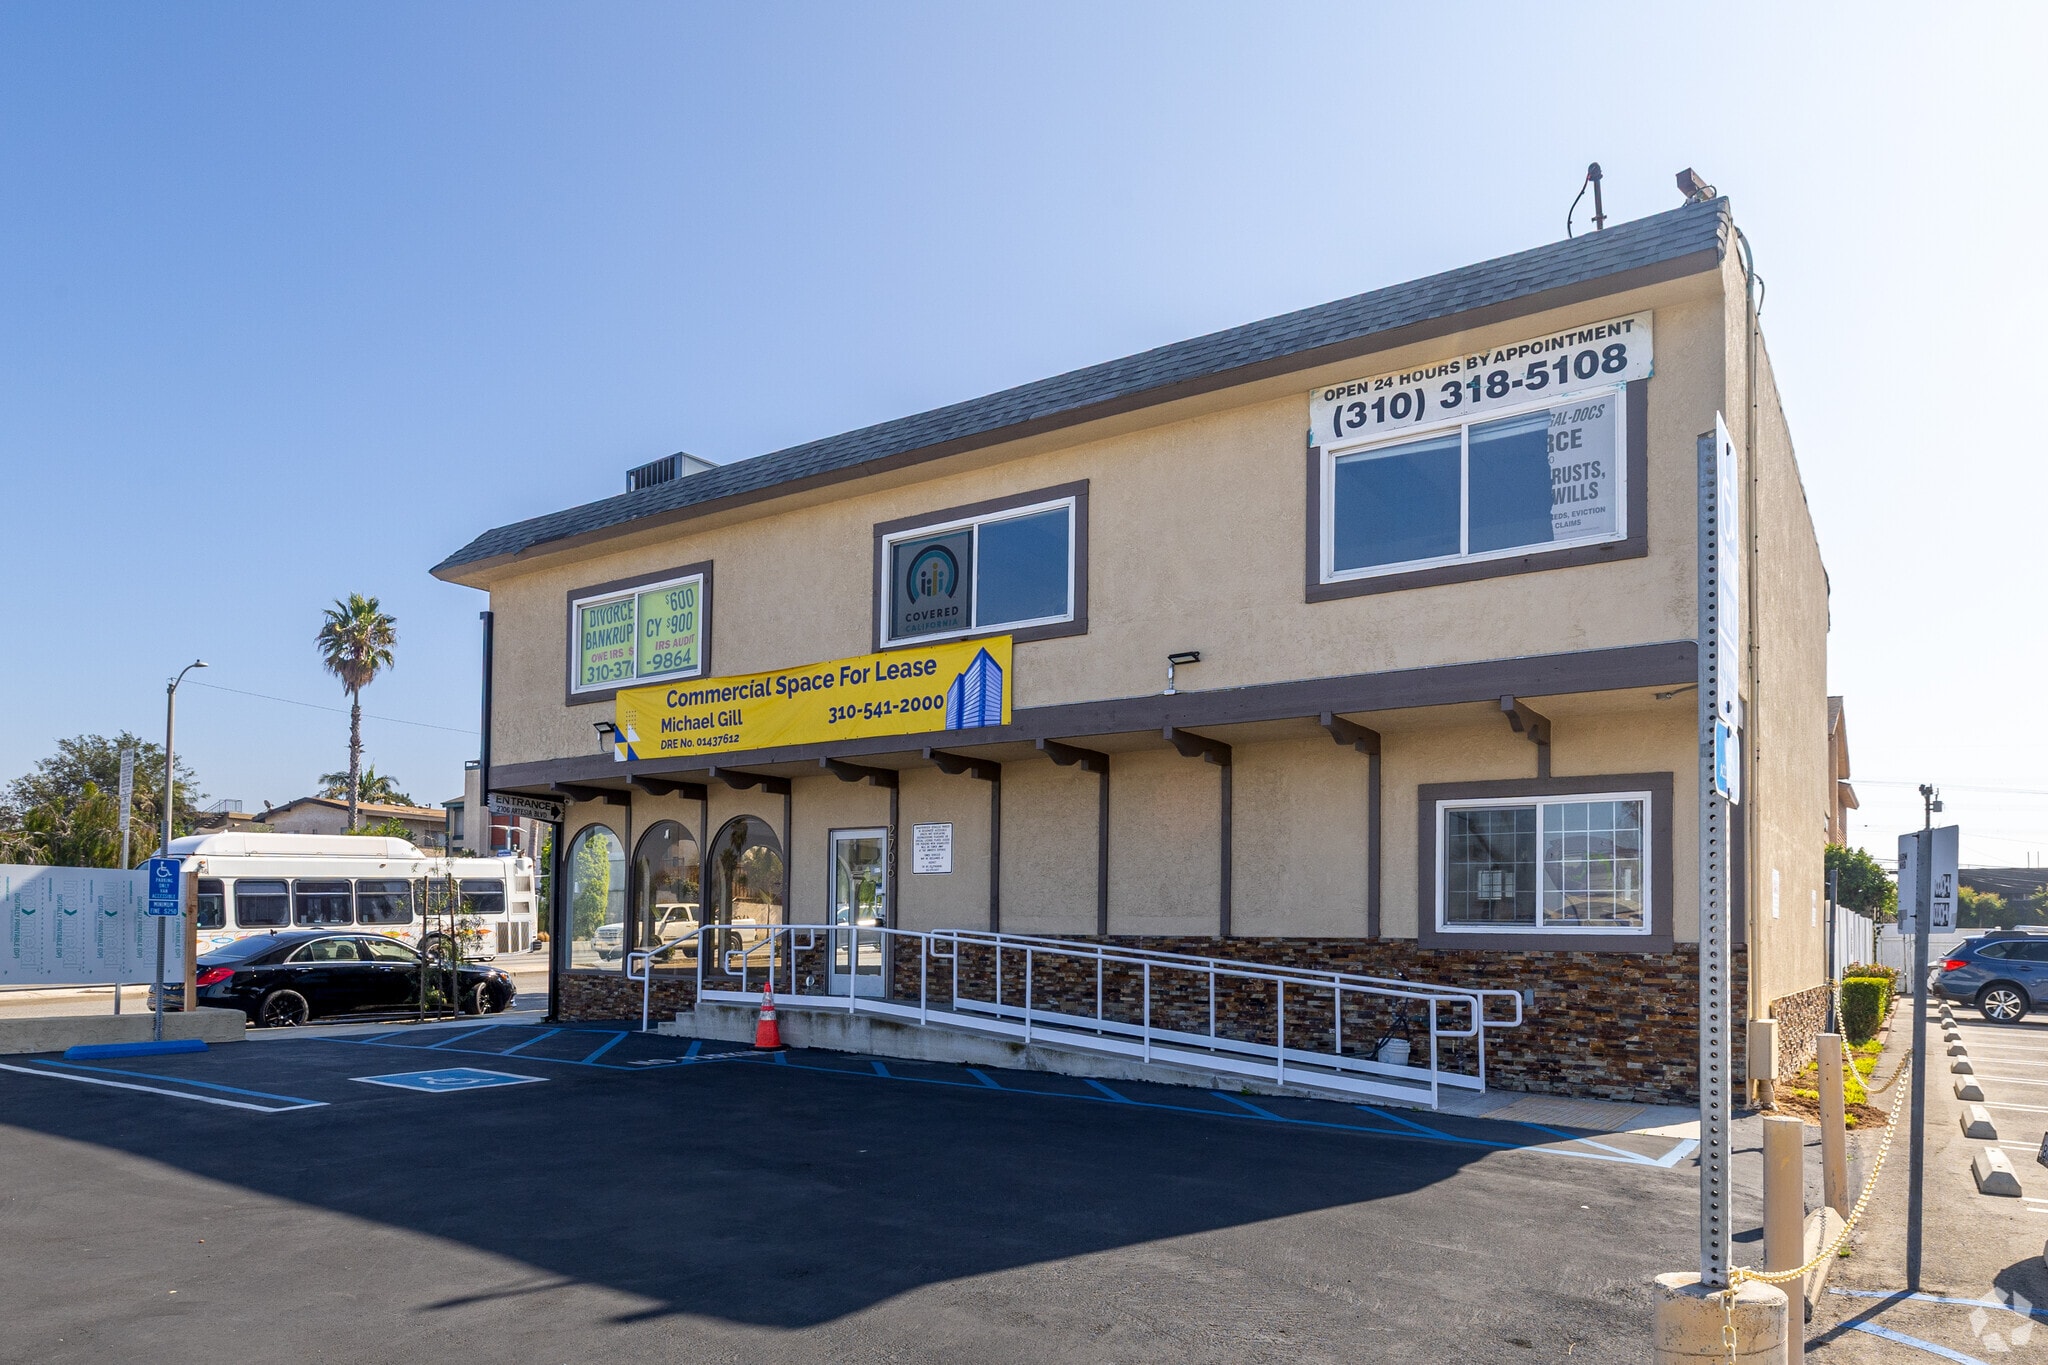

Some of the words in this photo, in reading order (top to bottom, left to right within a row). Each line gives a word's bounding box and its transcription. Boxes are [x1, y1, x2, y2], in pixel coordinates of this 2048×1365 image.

[1324, 381, 1368, 401] OPEN
[1374, 376, 1394, 391] 24
[1400, 361, 1460, 385] HOURS
[1466, 353, 1490, 370] BY
[1493, 319, 1635, 364] APPOINTMENT
[1333, 388, 1426, 438] (310)
[1440, 343, 1628, 409] 318-5108
[1552, 481, 1599, 506] WILLS
[1555, 519, 1582, 529] CLAIMS
[1572, 506, 1606, 518] EVICTION
[665, 588, 694, 612] $600
[589, 601, 634, 628] DIVORCE
[905, 606, 959, 622] COVERED
[905, 619, 958, 632] CALIFORNIA
[591, 651, 608, 663] OWE
[610, 648, 624, 659] IRS
[655, 638, 670, 650] IRS
[672, 634, 695, 648] AUDIT
[666, 677, 772, 708] Commercial
[775, 672, 835, 699] Space
[840, 665, 871, 686] For
[875, 659, 937, 682] Lease
[661, 712, 714, 733] Michael
[717, 709, 743, 727] Gill
[828, 694, 944, 724] 310-541-2000
[660, 739, 678, 750] DRE
[680, 738, 695, 749] No.
[697, 734, 740, 748] 01437612
[495, 795, 552, 811] ENTRANCE
[496, 805, 511, 814] 2706
[511, 807, 532, 817] ARTESIA
